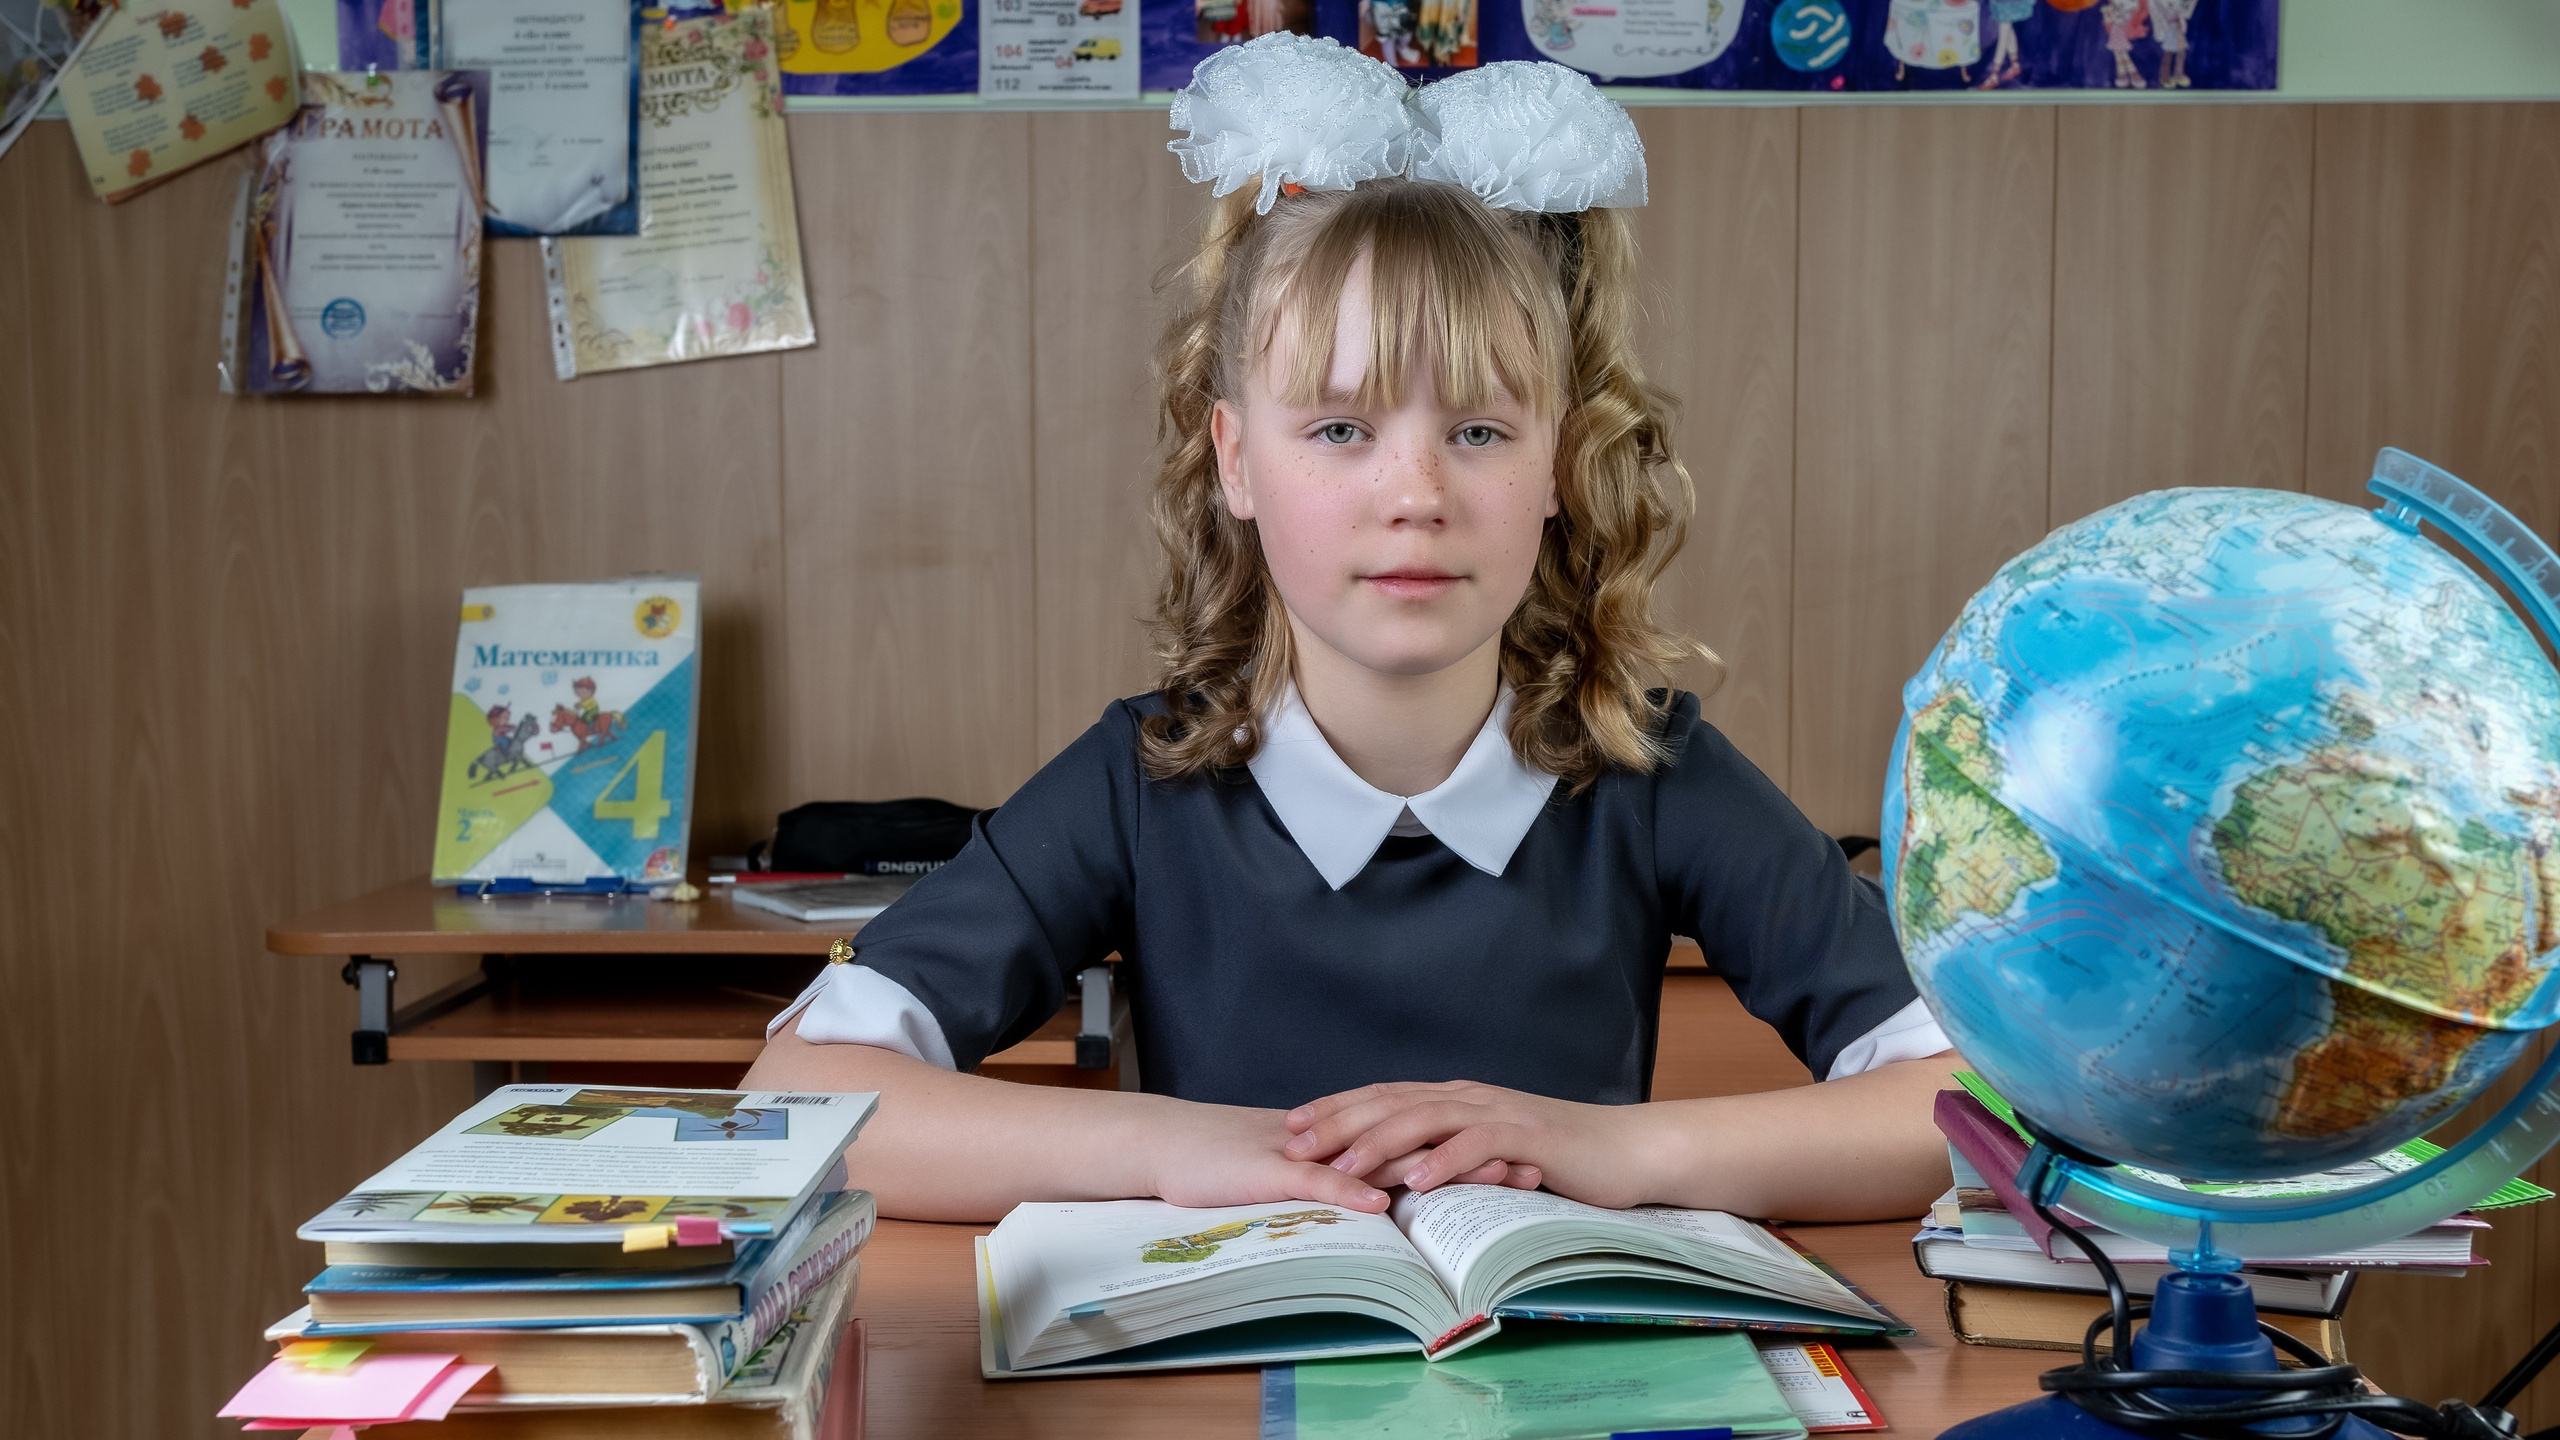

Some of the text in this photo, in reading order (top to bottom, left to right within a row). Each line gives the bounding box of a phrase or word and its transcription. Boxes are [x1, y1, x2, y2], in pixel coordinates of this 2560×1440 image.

[996, 44, 1022, 58] 104
[295, 113, 443, 140] ГРАМОТА
[472, 643, 660, 667] Математика
[592, 729, 671, 841] 4
[456, 819, 472, 841] 2
